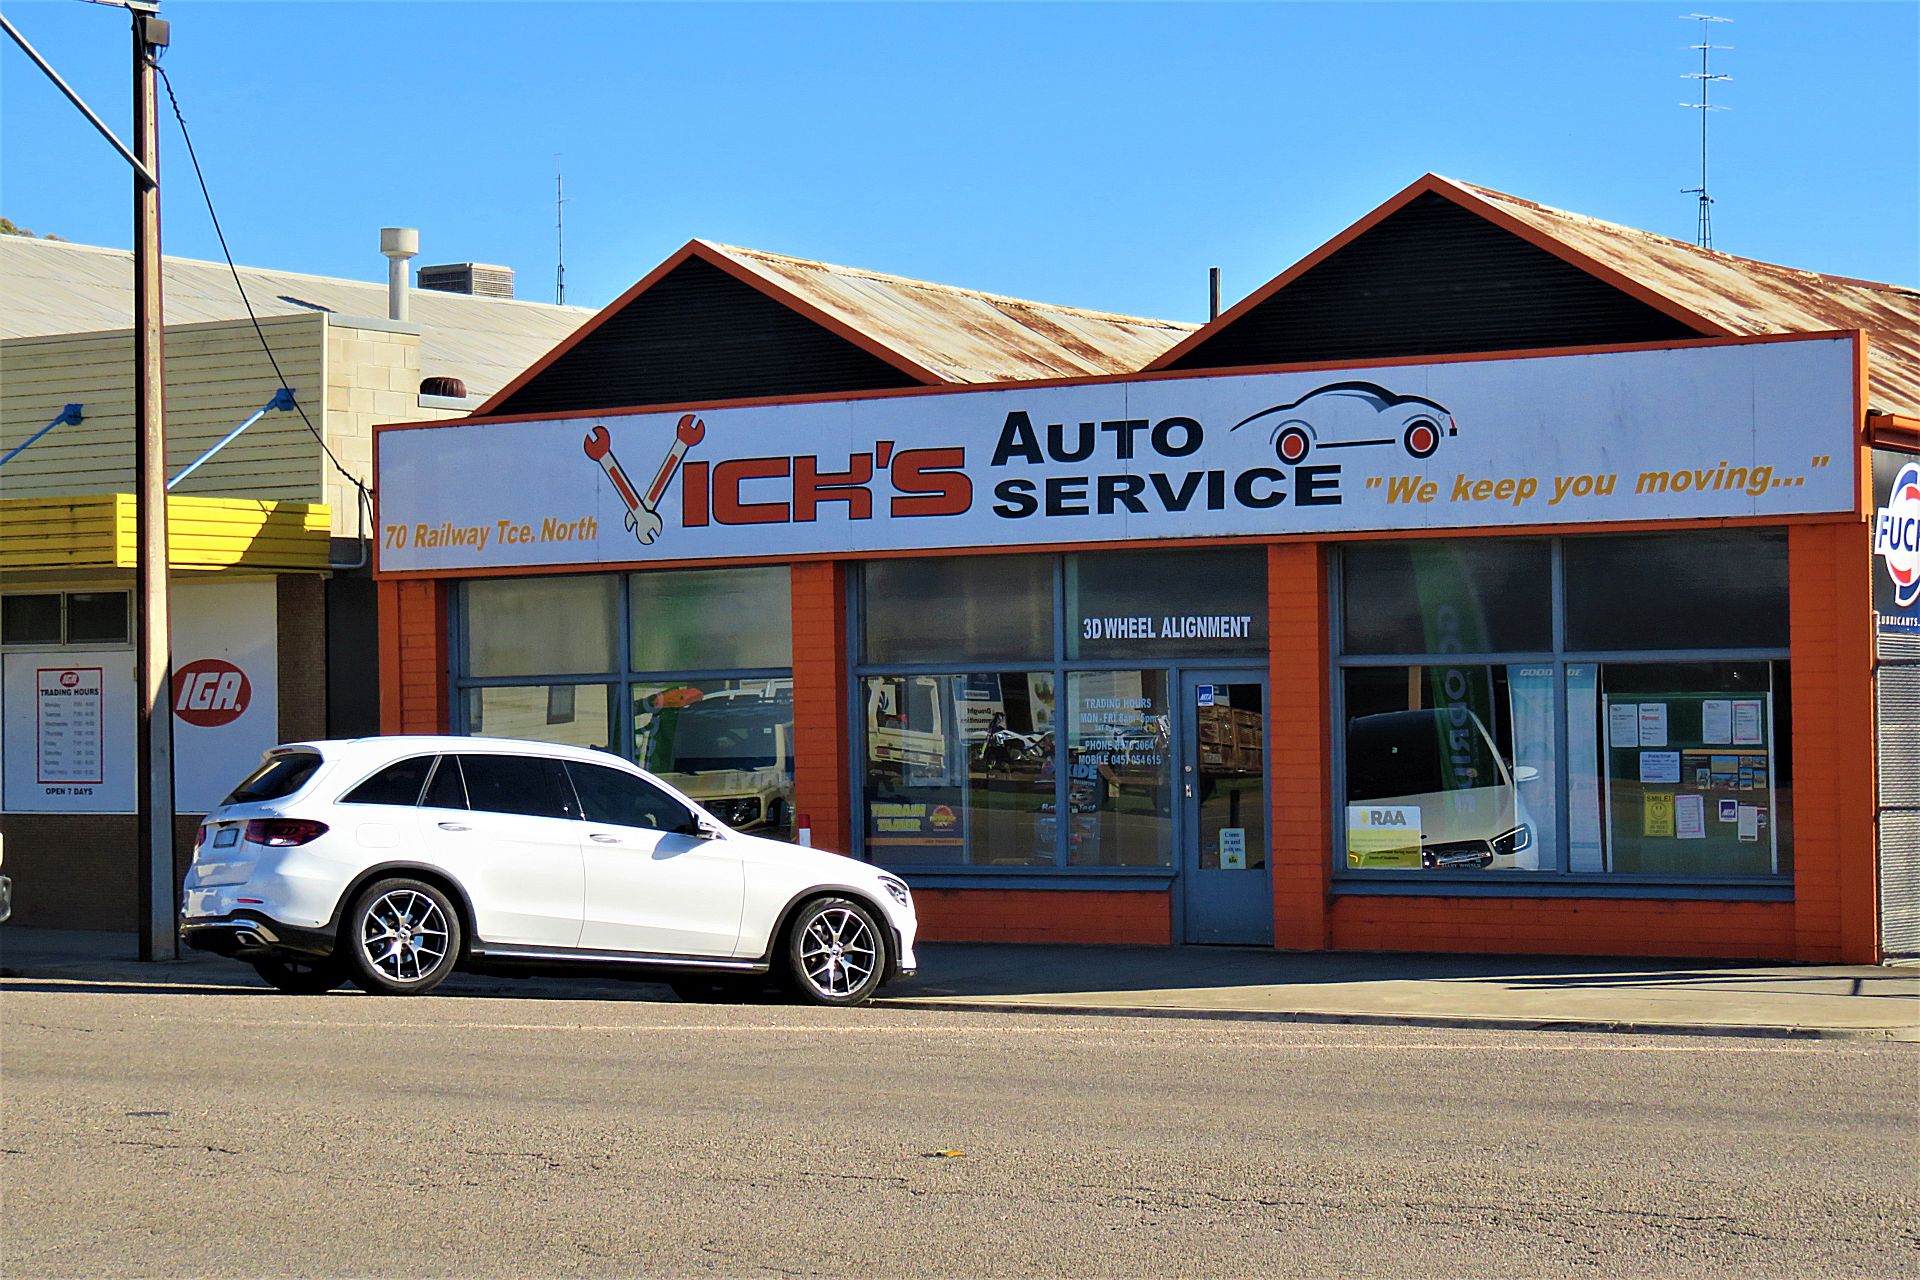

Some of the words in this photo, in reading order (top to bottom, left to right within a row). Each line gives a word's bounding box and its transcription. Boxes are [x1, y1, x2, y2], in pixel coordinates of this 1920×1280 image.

[990, 411, 1204, 467] AUTO
[992, 464, 1343, 520] SERVICE
[1450, 473, 1538, 506] keep
[1548, 470, 1616, 506] you
[385, 525, 408, 549] 70
[414, 523, 490, 551] Railway
[497, 520, 536, 545] Tce.
[541, 516, 599, 542] North
[1083, 618, 1102, 640] 3D
[1104, 617, 1157, 639] WHEEL
[1161, 616, 1251, 639] ALIGNMENT
[1519, 668, 1584, 677] GOODDE
[40, 688, 72, 697] TRADING
[74, 687, 99, 696] HOURS
[1086, 698, 1121, 709] TRADING
[1123, 698, 1152, 709] HOURS
[1085, 740, 1112, 750] PHONE
[1078, 754, 1109, 765] MOBILE
[45, 787, 66, 796] OPEN
[74, 787, 93, 796] DAYS
[1370, 810, 1407, 826] RAA
